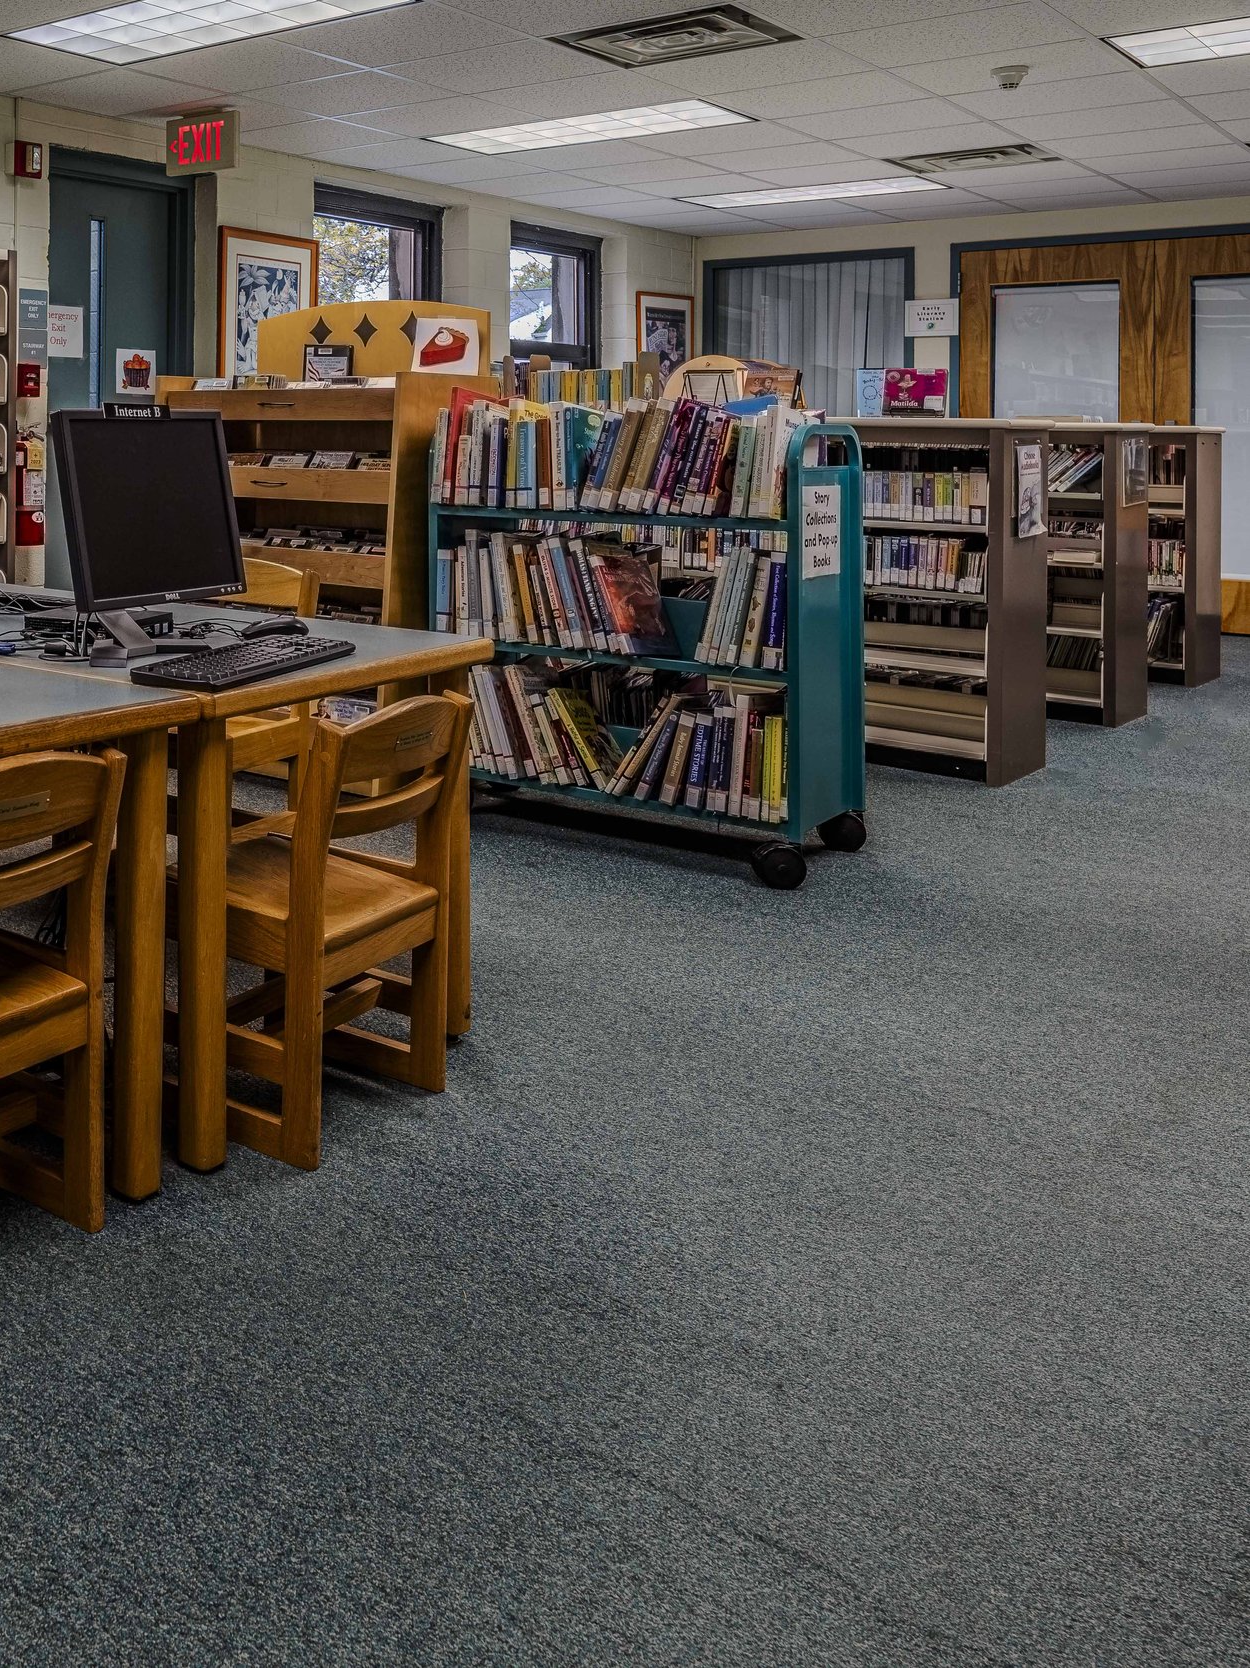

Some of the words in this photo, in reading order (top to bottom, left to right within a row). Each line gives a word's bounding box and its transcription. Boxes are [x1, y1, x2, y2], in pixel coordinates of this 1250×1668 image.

[178, 120, 225, 165] EXIT
[49, 312, 79, 322] ergency
[51, 323, 66, 332] Exit
[50, 336, 67, 347] Only
[114, 405, 152, 417] Internet
[153, 406, 161, 417] B
[518, 427, 526, 456] Treasury
[617, 422, 631, 446] Treasury
[616, 446, 623, 454] of
[1023, 451, 1036, 460] Choose
[814, 491, 830, 507] Story
[806, 511, 837, 526] Collections
[804, 533, 817, 548] and
[818, 533, 838, 549] Pop-up
[539, 555, 547, 571] OLIVIA
[575, 549, 587, 572] OMAS
[813, 553, 831, 568] Books
[660, 731, 669, 743] Peppa
[677, 731, 687, 744] Baby
[693, 724, 704, 752] EDTIME
[652, 748, 662, 761] Story
[673, 743, 684, 760] Animal
[645, 759, 657, 777] Treasury
[669, 760, 679, 777] Stories
[689, 752, 700, 782] STORIES
